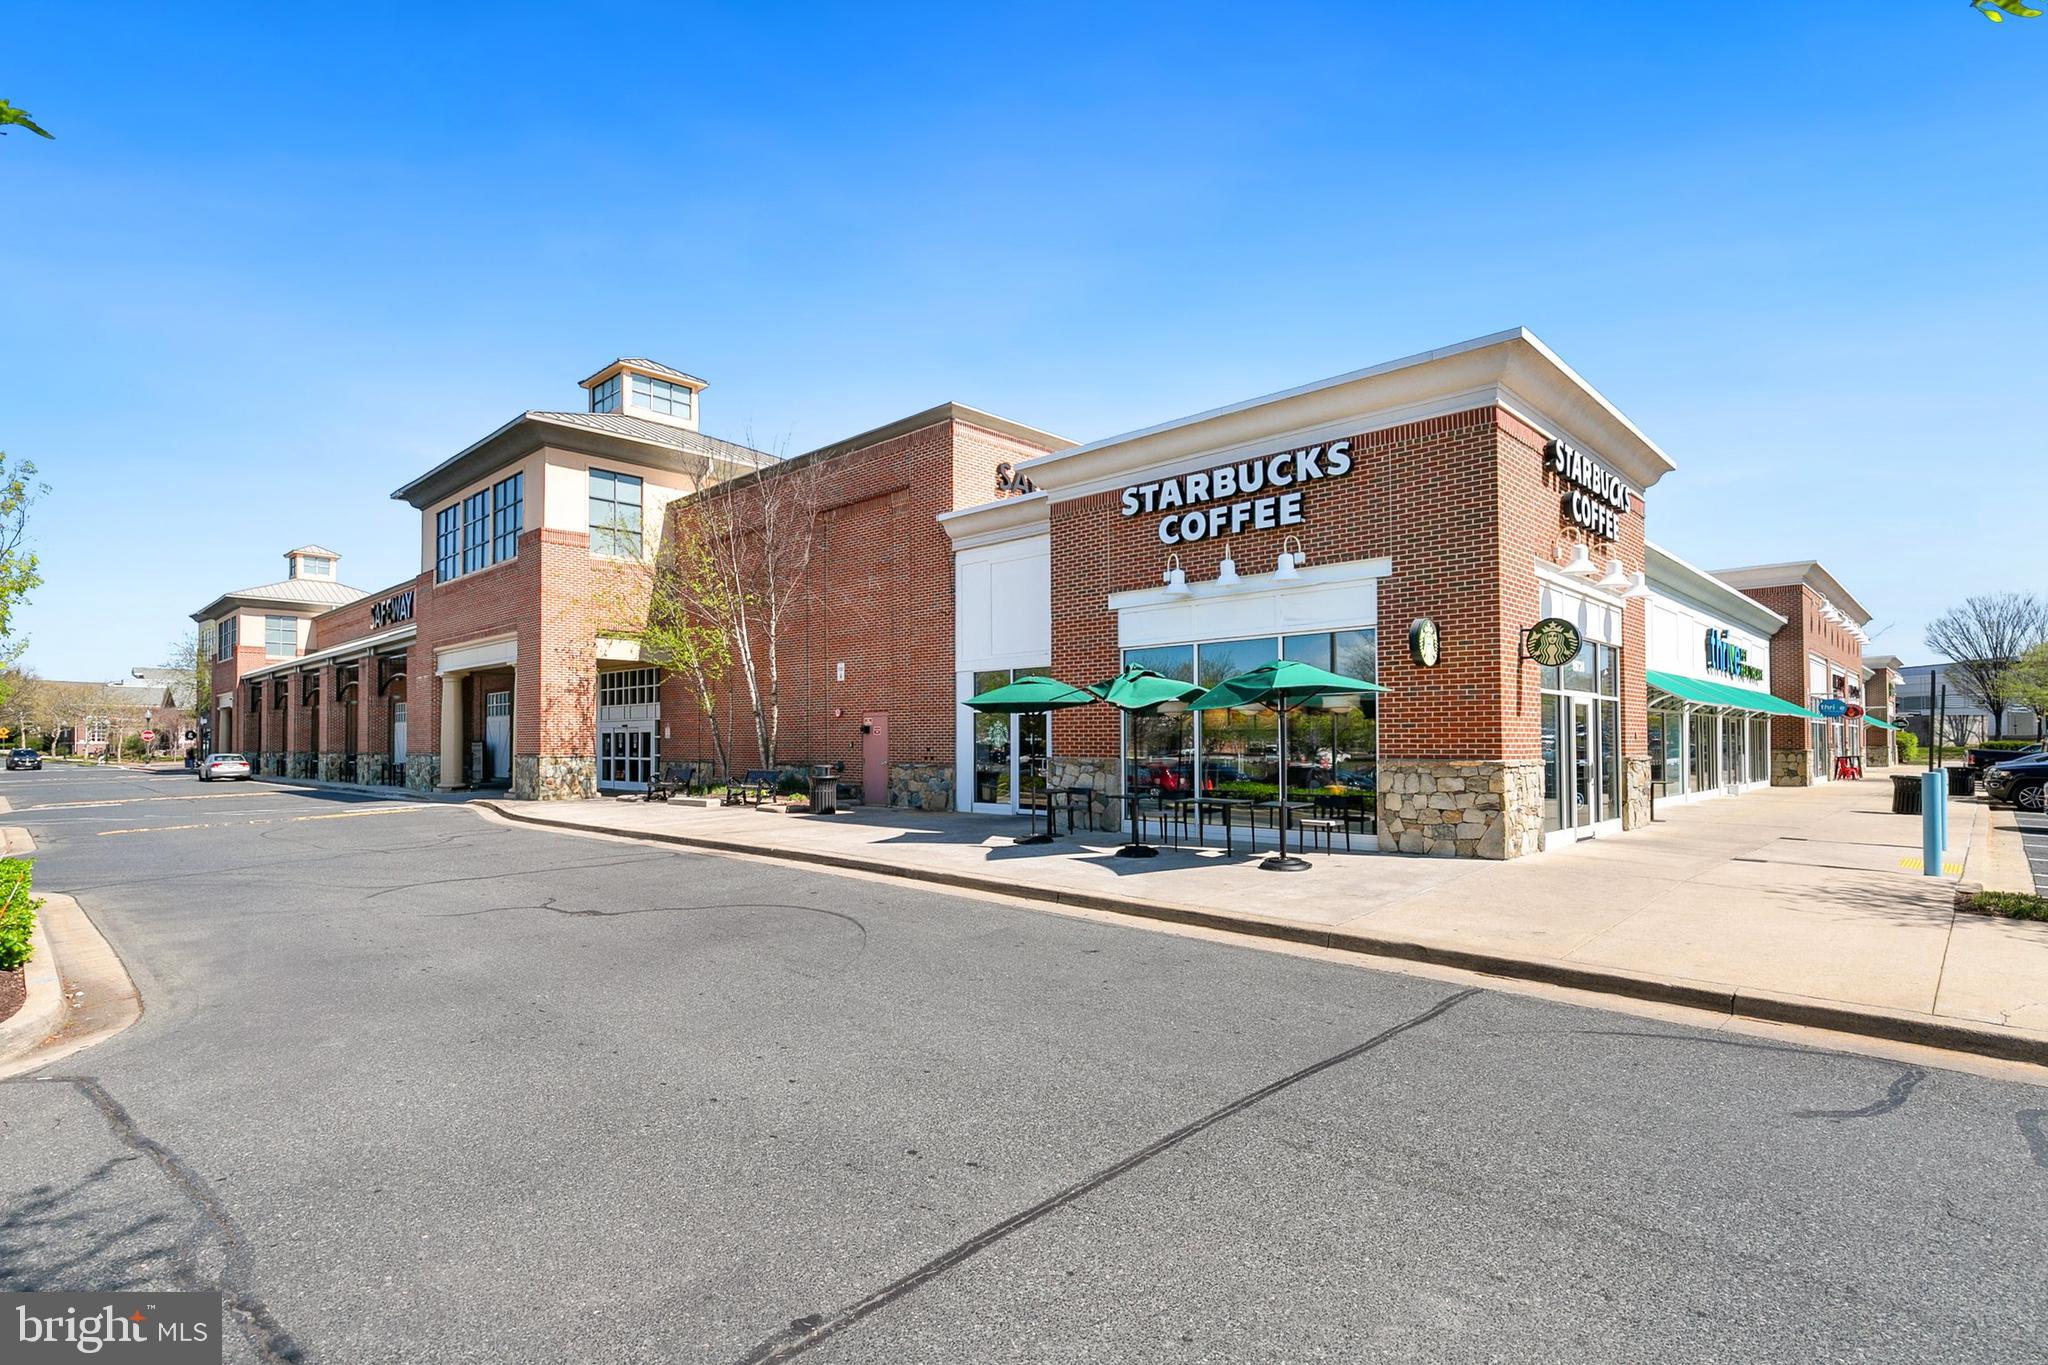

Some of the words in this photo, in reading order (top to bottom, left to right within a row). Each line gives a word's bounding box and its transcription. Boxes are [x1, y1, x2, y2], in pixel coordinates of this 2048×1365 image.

[997, 462, 1036, 495] SA
[1121, 441, 1352, 517] STARBUCKS
[1555, 438, 1631, 514] STARBUCKS
[1158, 492, 1302, 545] COFFEE
[1572, 489, 1620, 542] COFFEE
[370, 590, 415, 630] SAFEWAY
[1708, 628, 1741, 676] thrive
[1820, 703, 1846, 712] thrie
